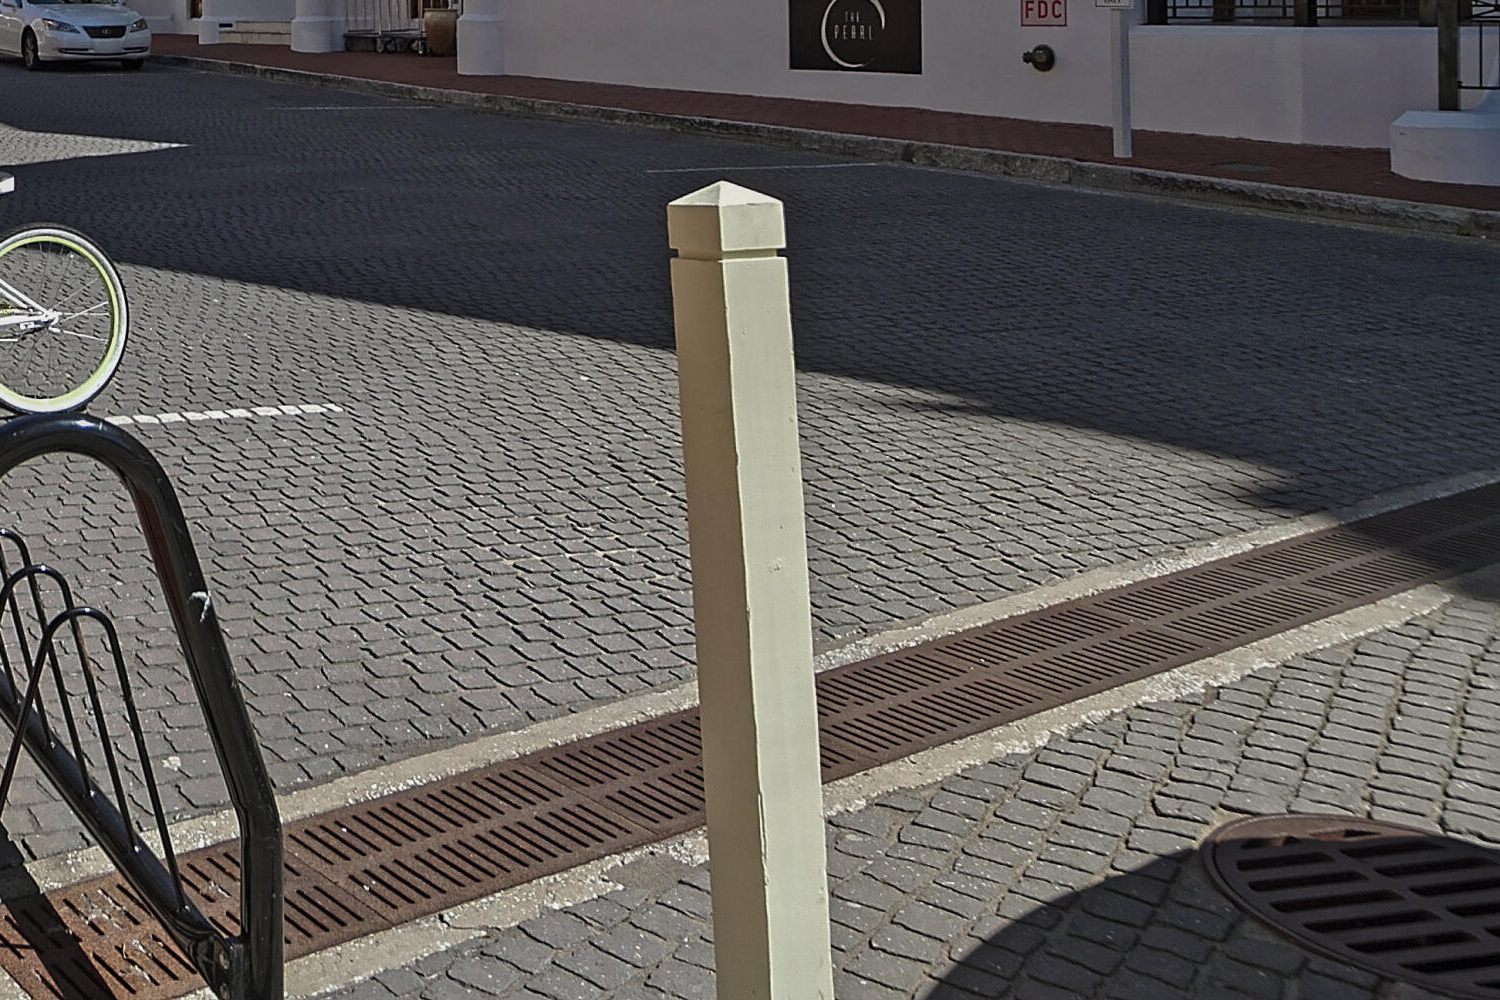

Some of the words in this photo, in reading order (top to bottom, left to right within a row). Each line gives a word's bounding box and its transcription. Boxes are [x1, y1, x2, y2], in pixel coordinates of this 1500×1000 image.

[845, 11, 860, 22] THE
[1024, 0, 1063, 19] FDC
[834, 25, 873, 40] PEARL
